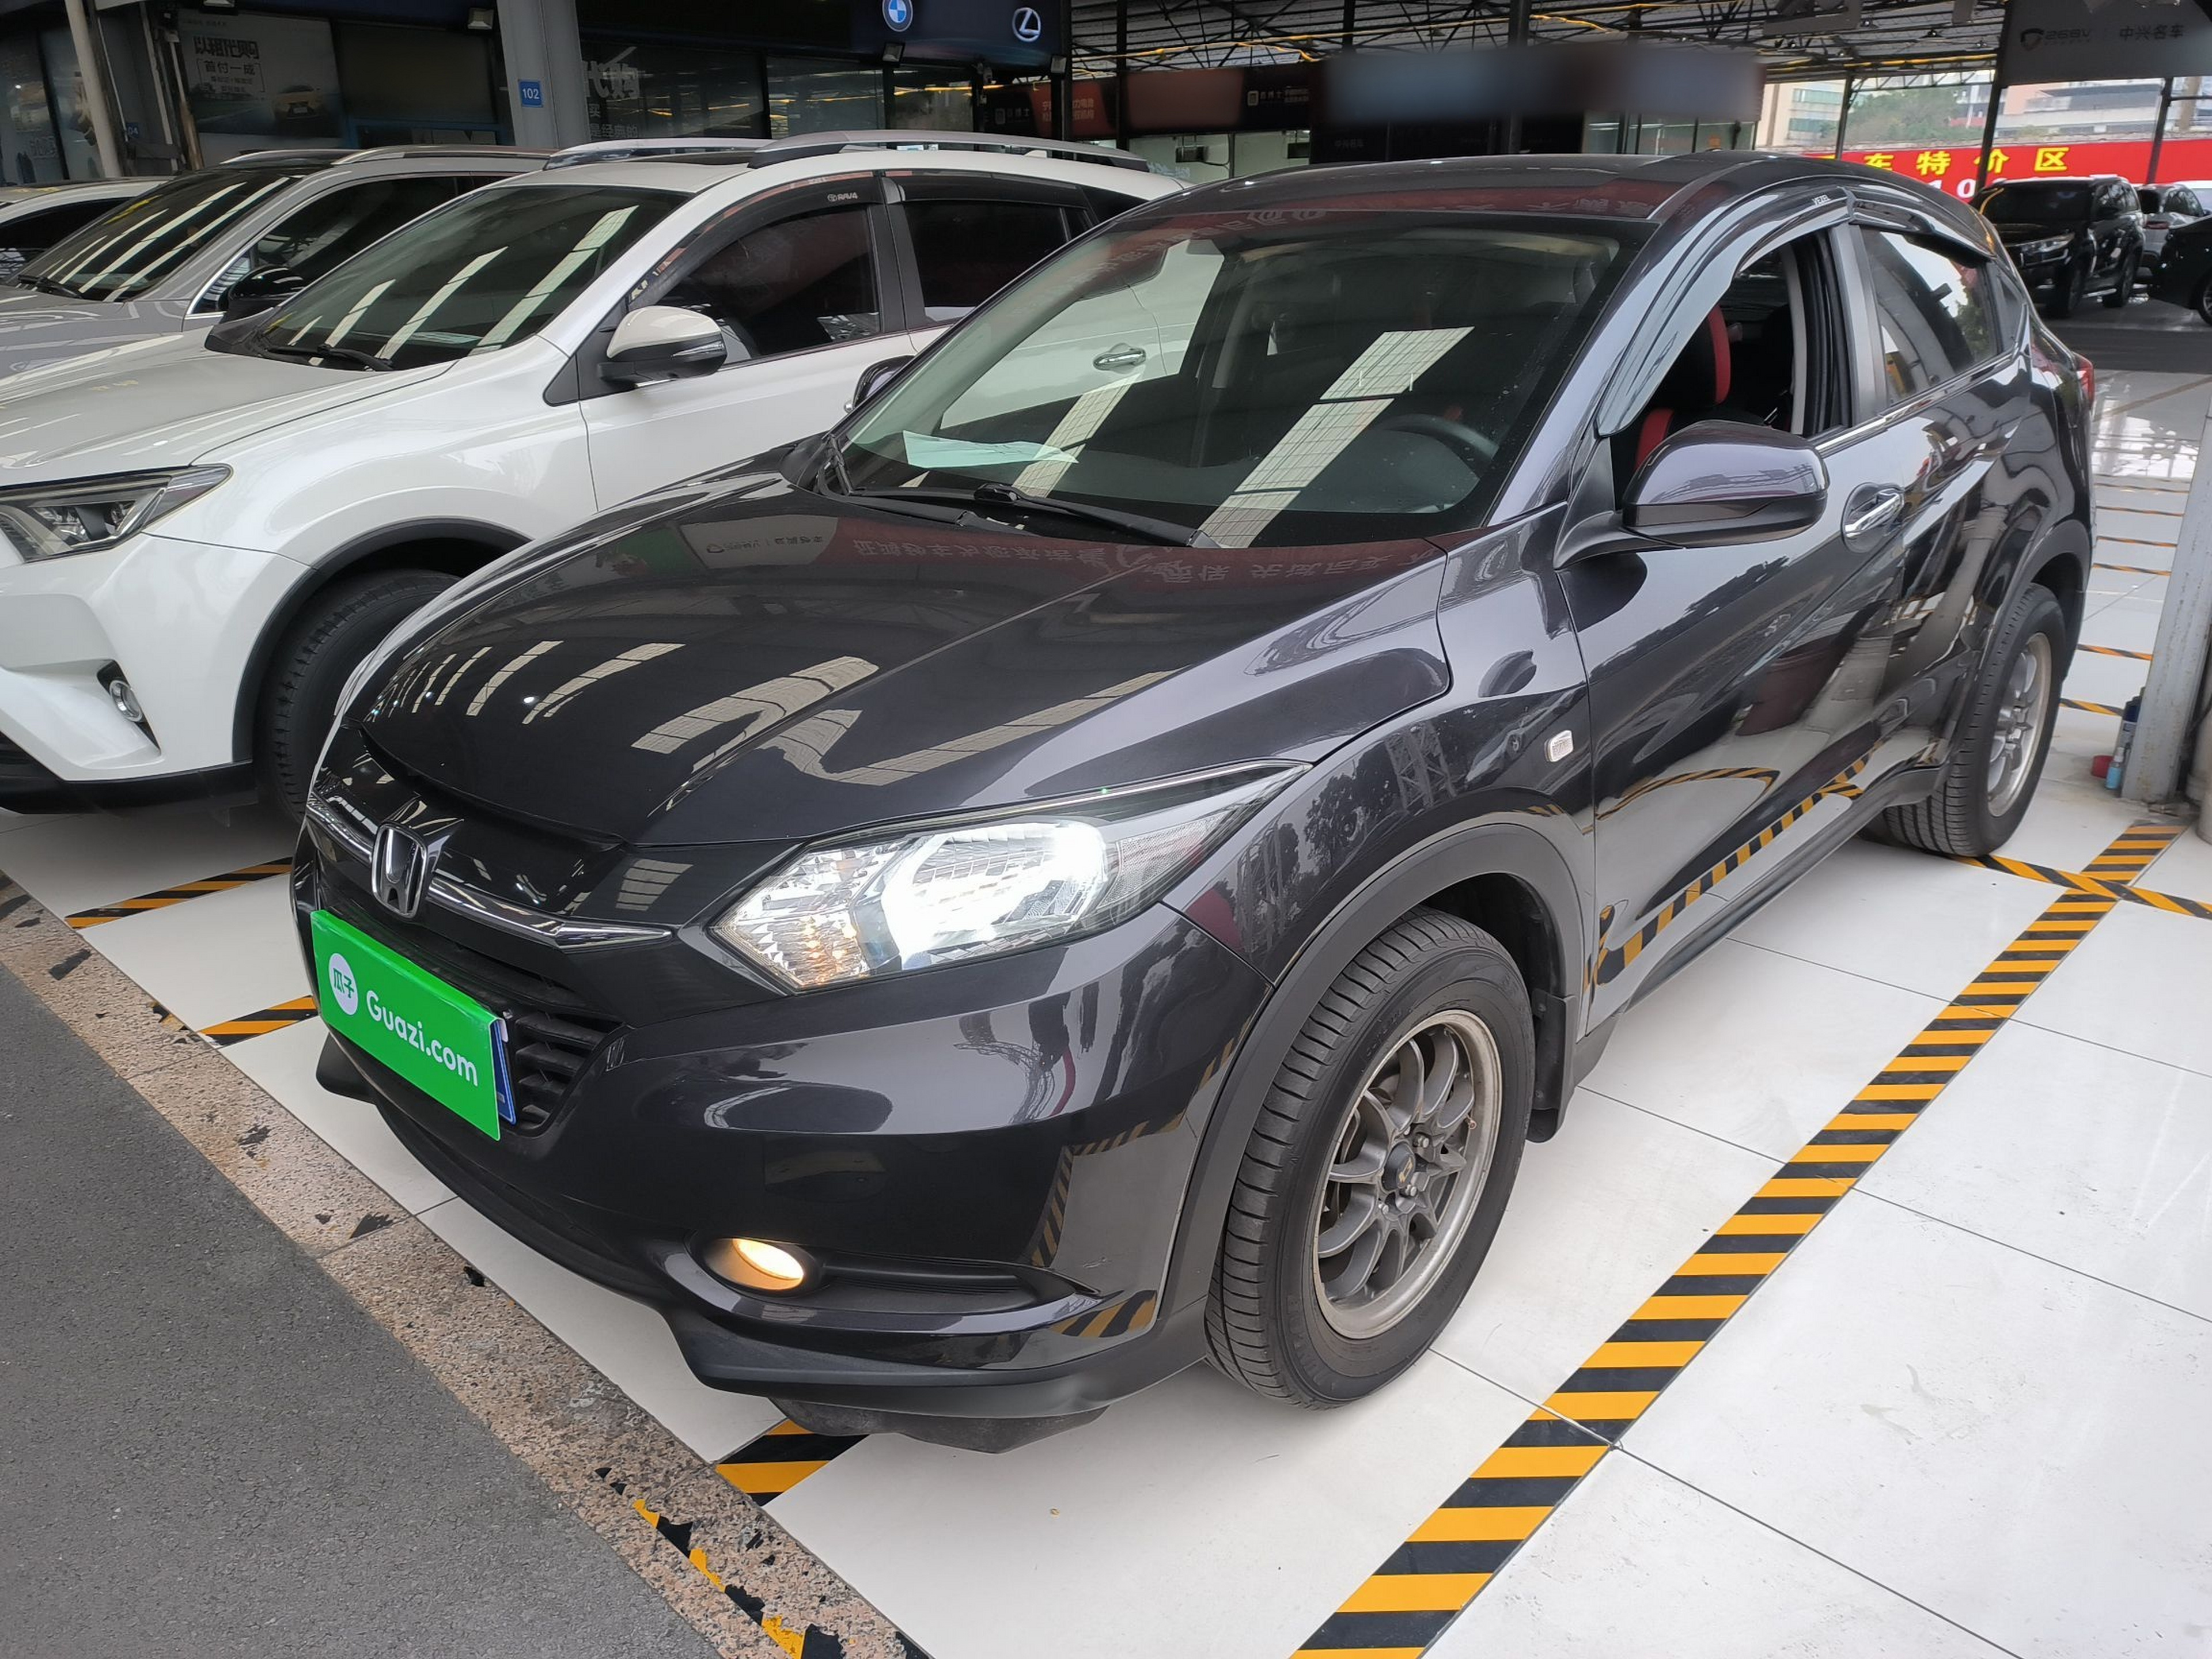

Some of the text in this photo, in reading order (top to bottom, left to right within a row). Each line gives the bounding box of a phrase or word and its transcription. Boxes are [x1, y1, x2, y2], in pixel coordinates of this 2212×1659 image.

[203, 60, 256, 75] 首付一成
[522, 88, 539, 100] 102
[837, 192, 858, 200] RAV4
[332, 967, 355, 999] 瓜子
[366, 990, 478, 1087] Guazi.com
